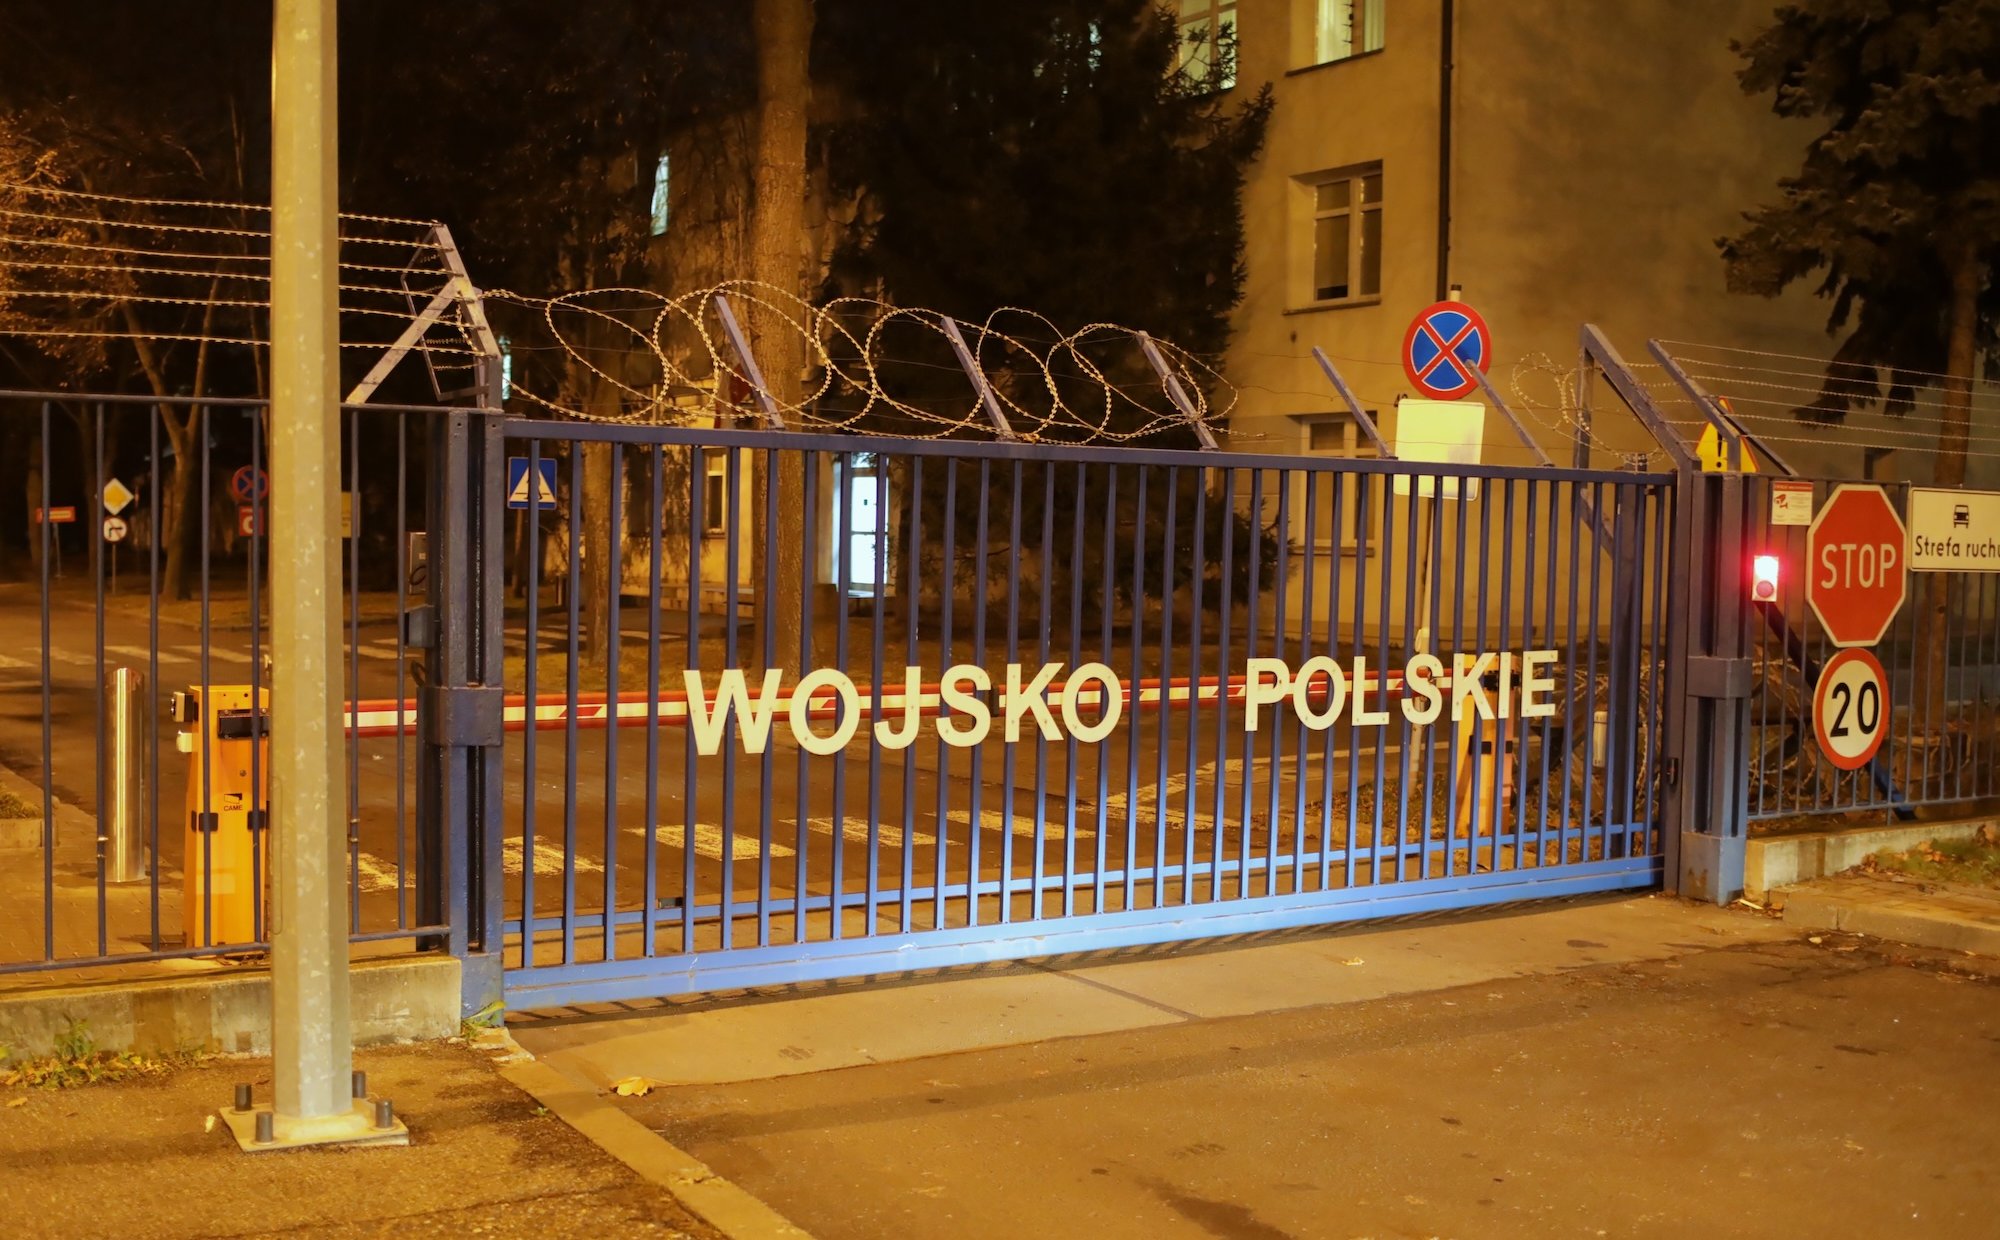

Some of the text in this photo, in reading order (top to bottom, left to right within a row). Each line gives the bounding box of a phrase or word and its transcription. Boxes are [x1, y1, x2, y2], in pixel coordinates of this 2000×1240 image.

[1821, 543, 1896, 589] STOP
[1914, 535, 1960, 557] Strefa
[683, 650, 1558, 756] WOJSKO POLSKIE
[1829, 680, 1880, 738] 20
[223, 804, 243, 812] CAME
